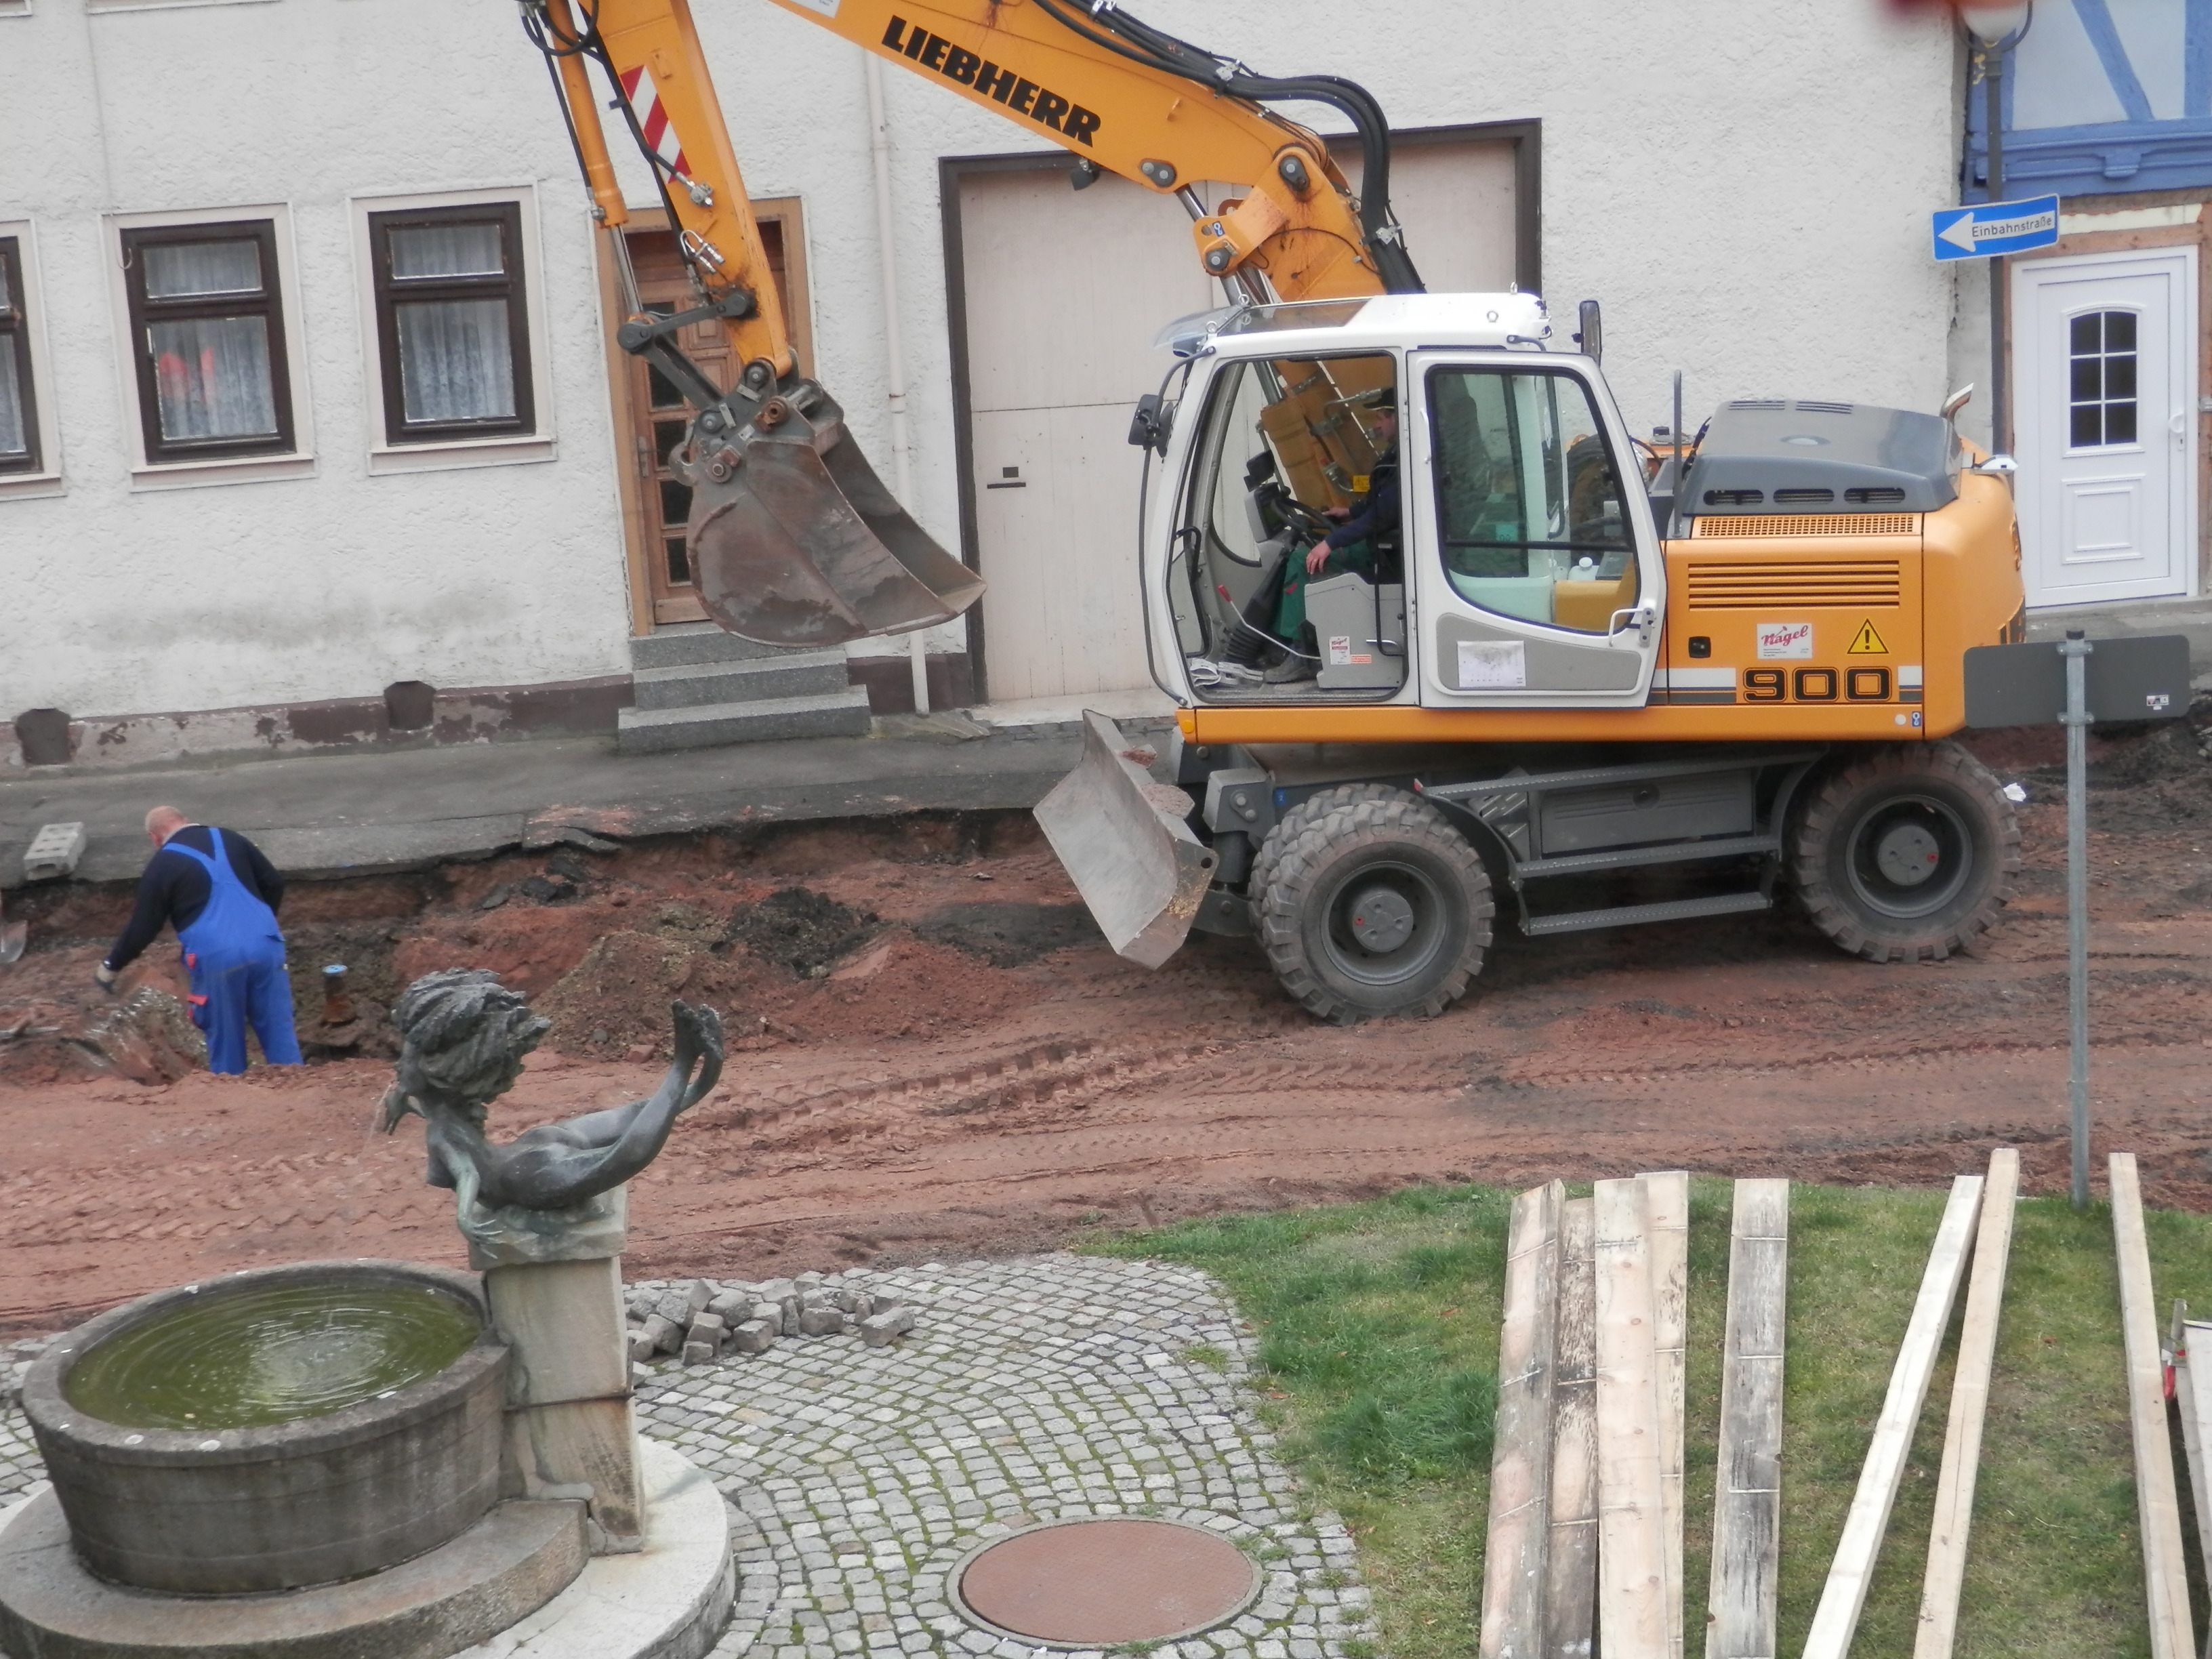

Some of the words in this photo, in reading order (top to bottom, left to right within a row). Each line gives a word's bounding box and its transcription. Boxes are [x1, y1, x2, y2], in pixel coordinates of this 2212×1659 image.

[882, 15, 1101, 147] LIEBHERR
[1972, 216, 2052, 237] Einbahnstraße
[1761, 625, 1808, 647] Nagel
[1742, 666, 1893, 702] 900
